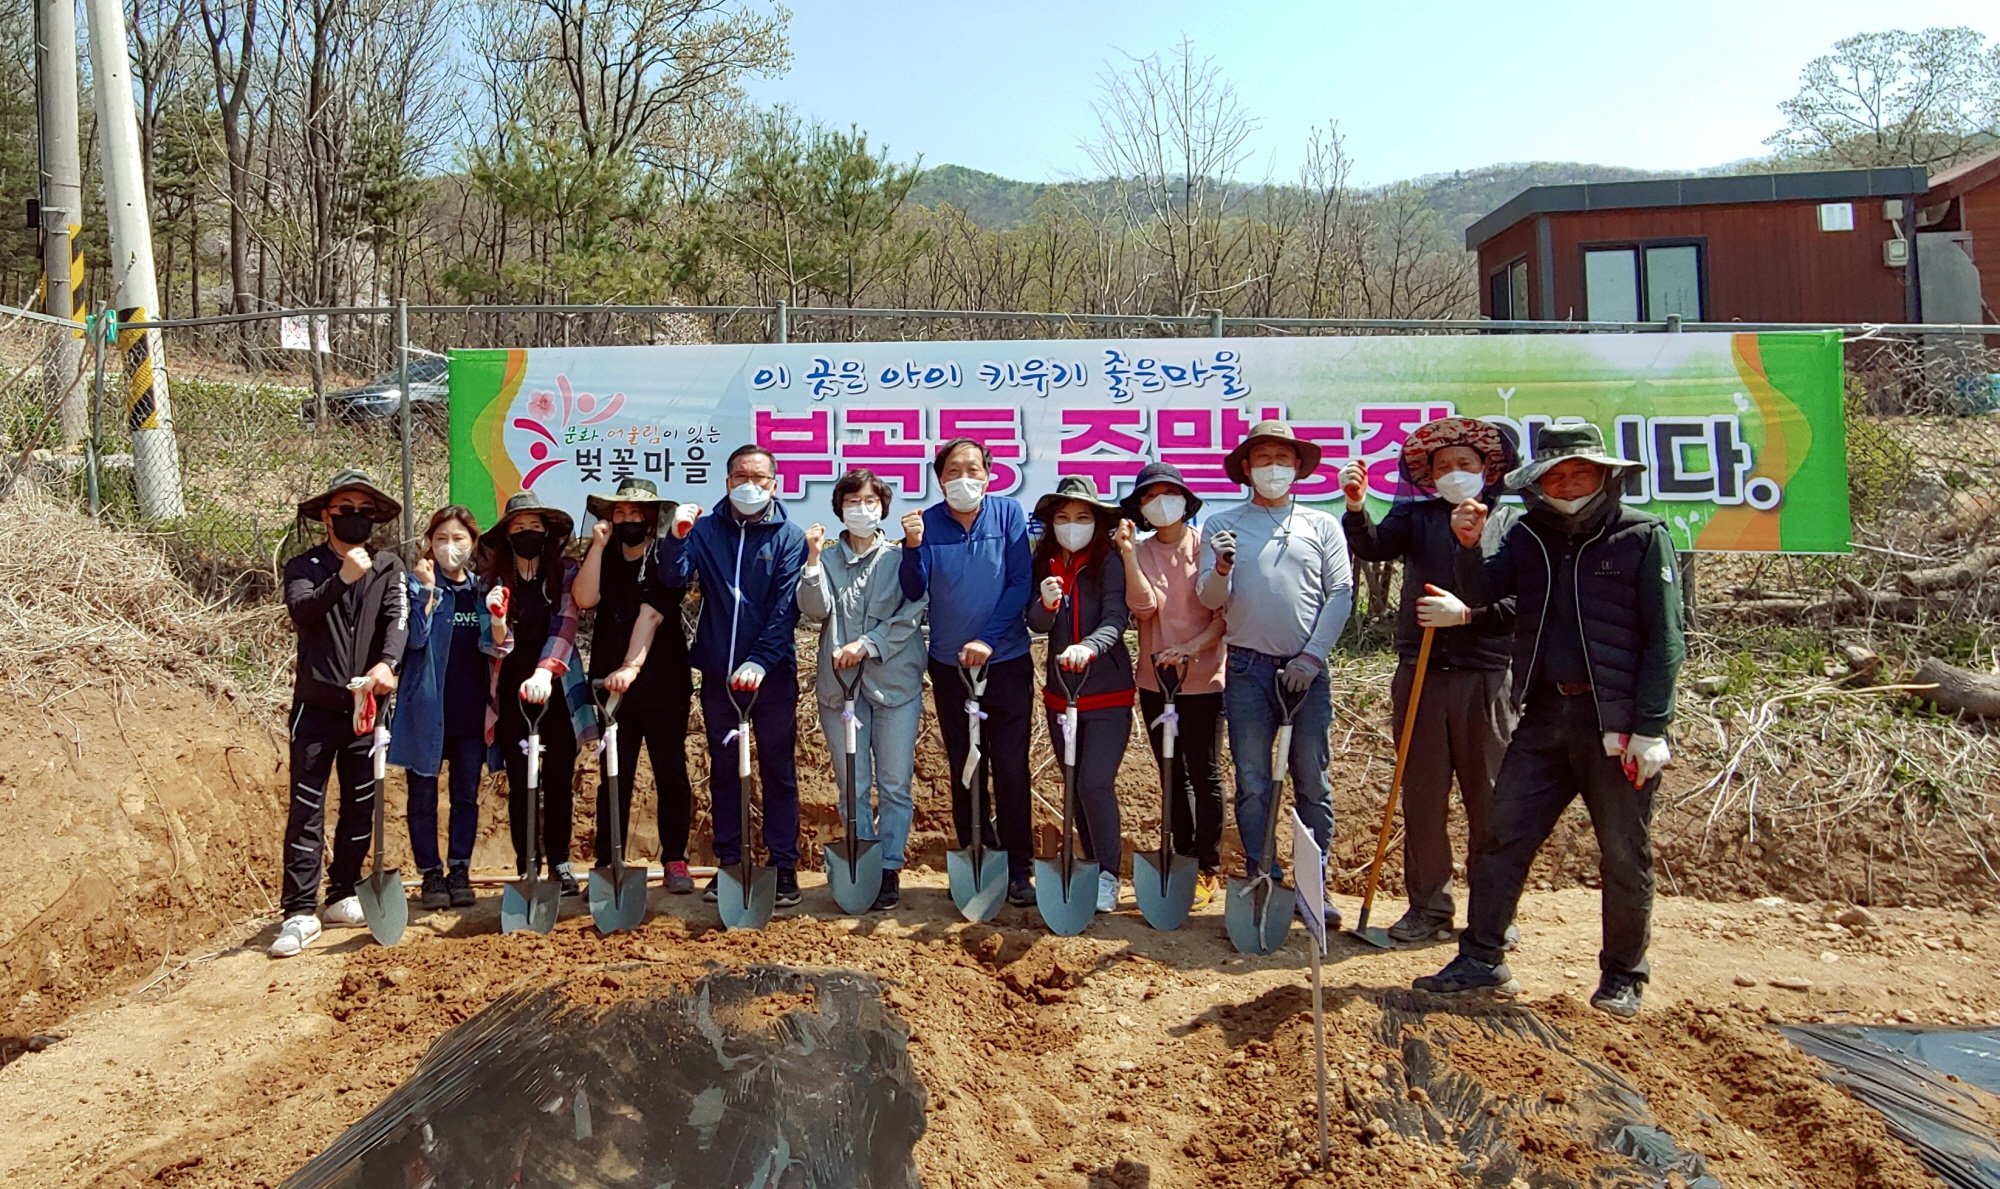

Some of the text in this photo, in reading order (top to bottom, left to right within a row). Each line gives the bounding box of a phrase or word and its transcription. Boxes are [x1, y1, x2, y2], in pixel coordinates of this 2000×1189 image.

[753, 349, 1246, 399] 이 곳은 아이 키우기 좋은마을
[685, 424, 722, 445] 있는
[755, 407, 1021, 494] 부곡동
[575, 446, 712, 485] 벚꽃마을
[453, 612, 480, 622] OVE
